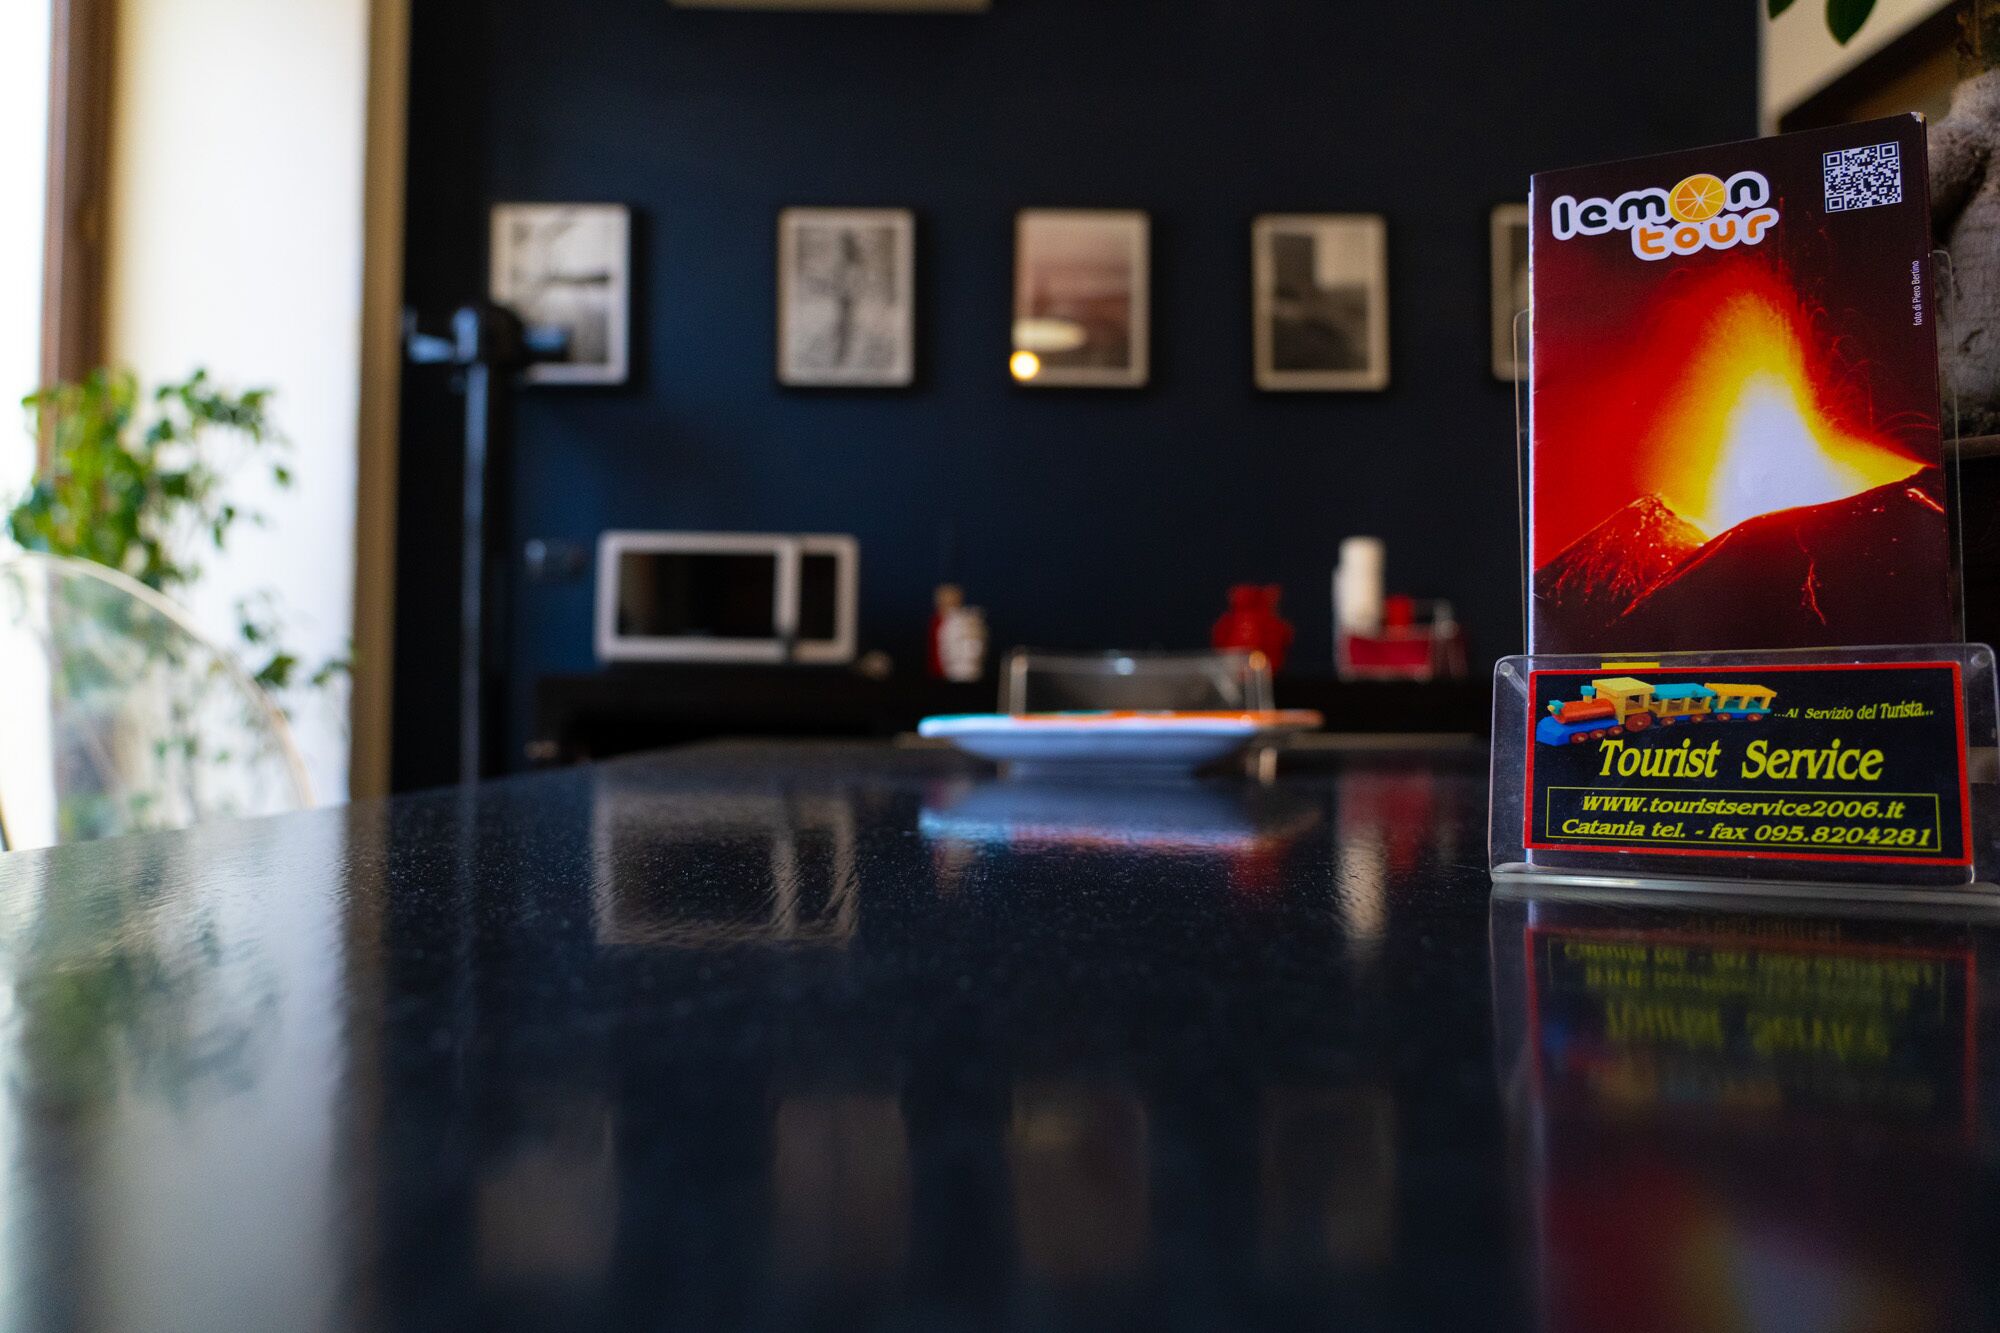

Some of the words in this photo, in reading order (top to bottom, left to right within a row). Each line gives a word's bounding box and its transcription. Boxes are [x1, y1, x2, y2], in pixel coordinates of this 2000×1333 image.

[1636, 211, 1775, 257] tour
[1910, 260, 1920, 285] Bertino
[1911, 285, 1921, 304] Piero
[1911, 303, 1922, 311] di
[1912, 311, 1923, 326] foto
[1804, 707, 1854, 720] Servizio
[1856, 704, 1877, 720] del
[1599, 738, 1721, 778] Tourist
[1741, 738, 1884, 780] Service
[1561, 818, 1646, 837] Catania
[1650, 822, 1686, 838] tel.
[1708, 823, 1749, 840] fax
[1754, 825, 1932, 846] 095.8204281
